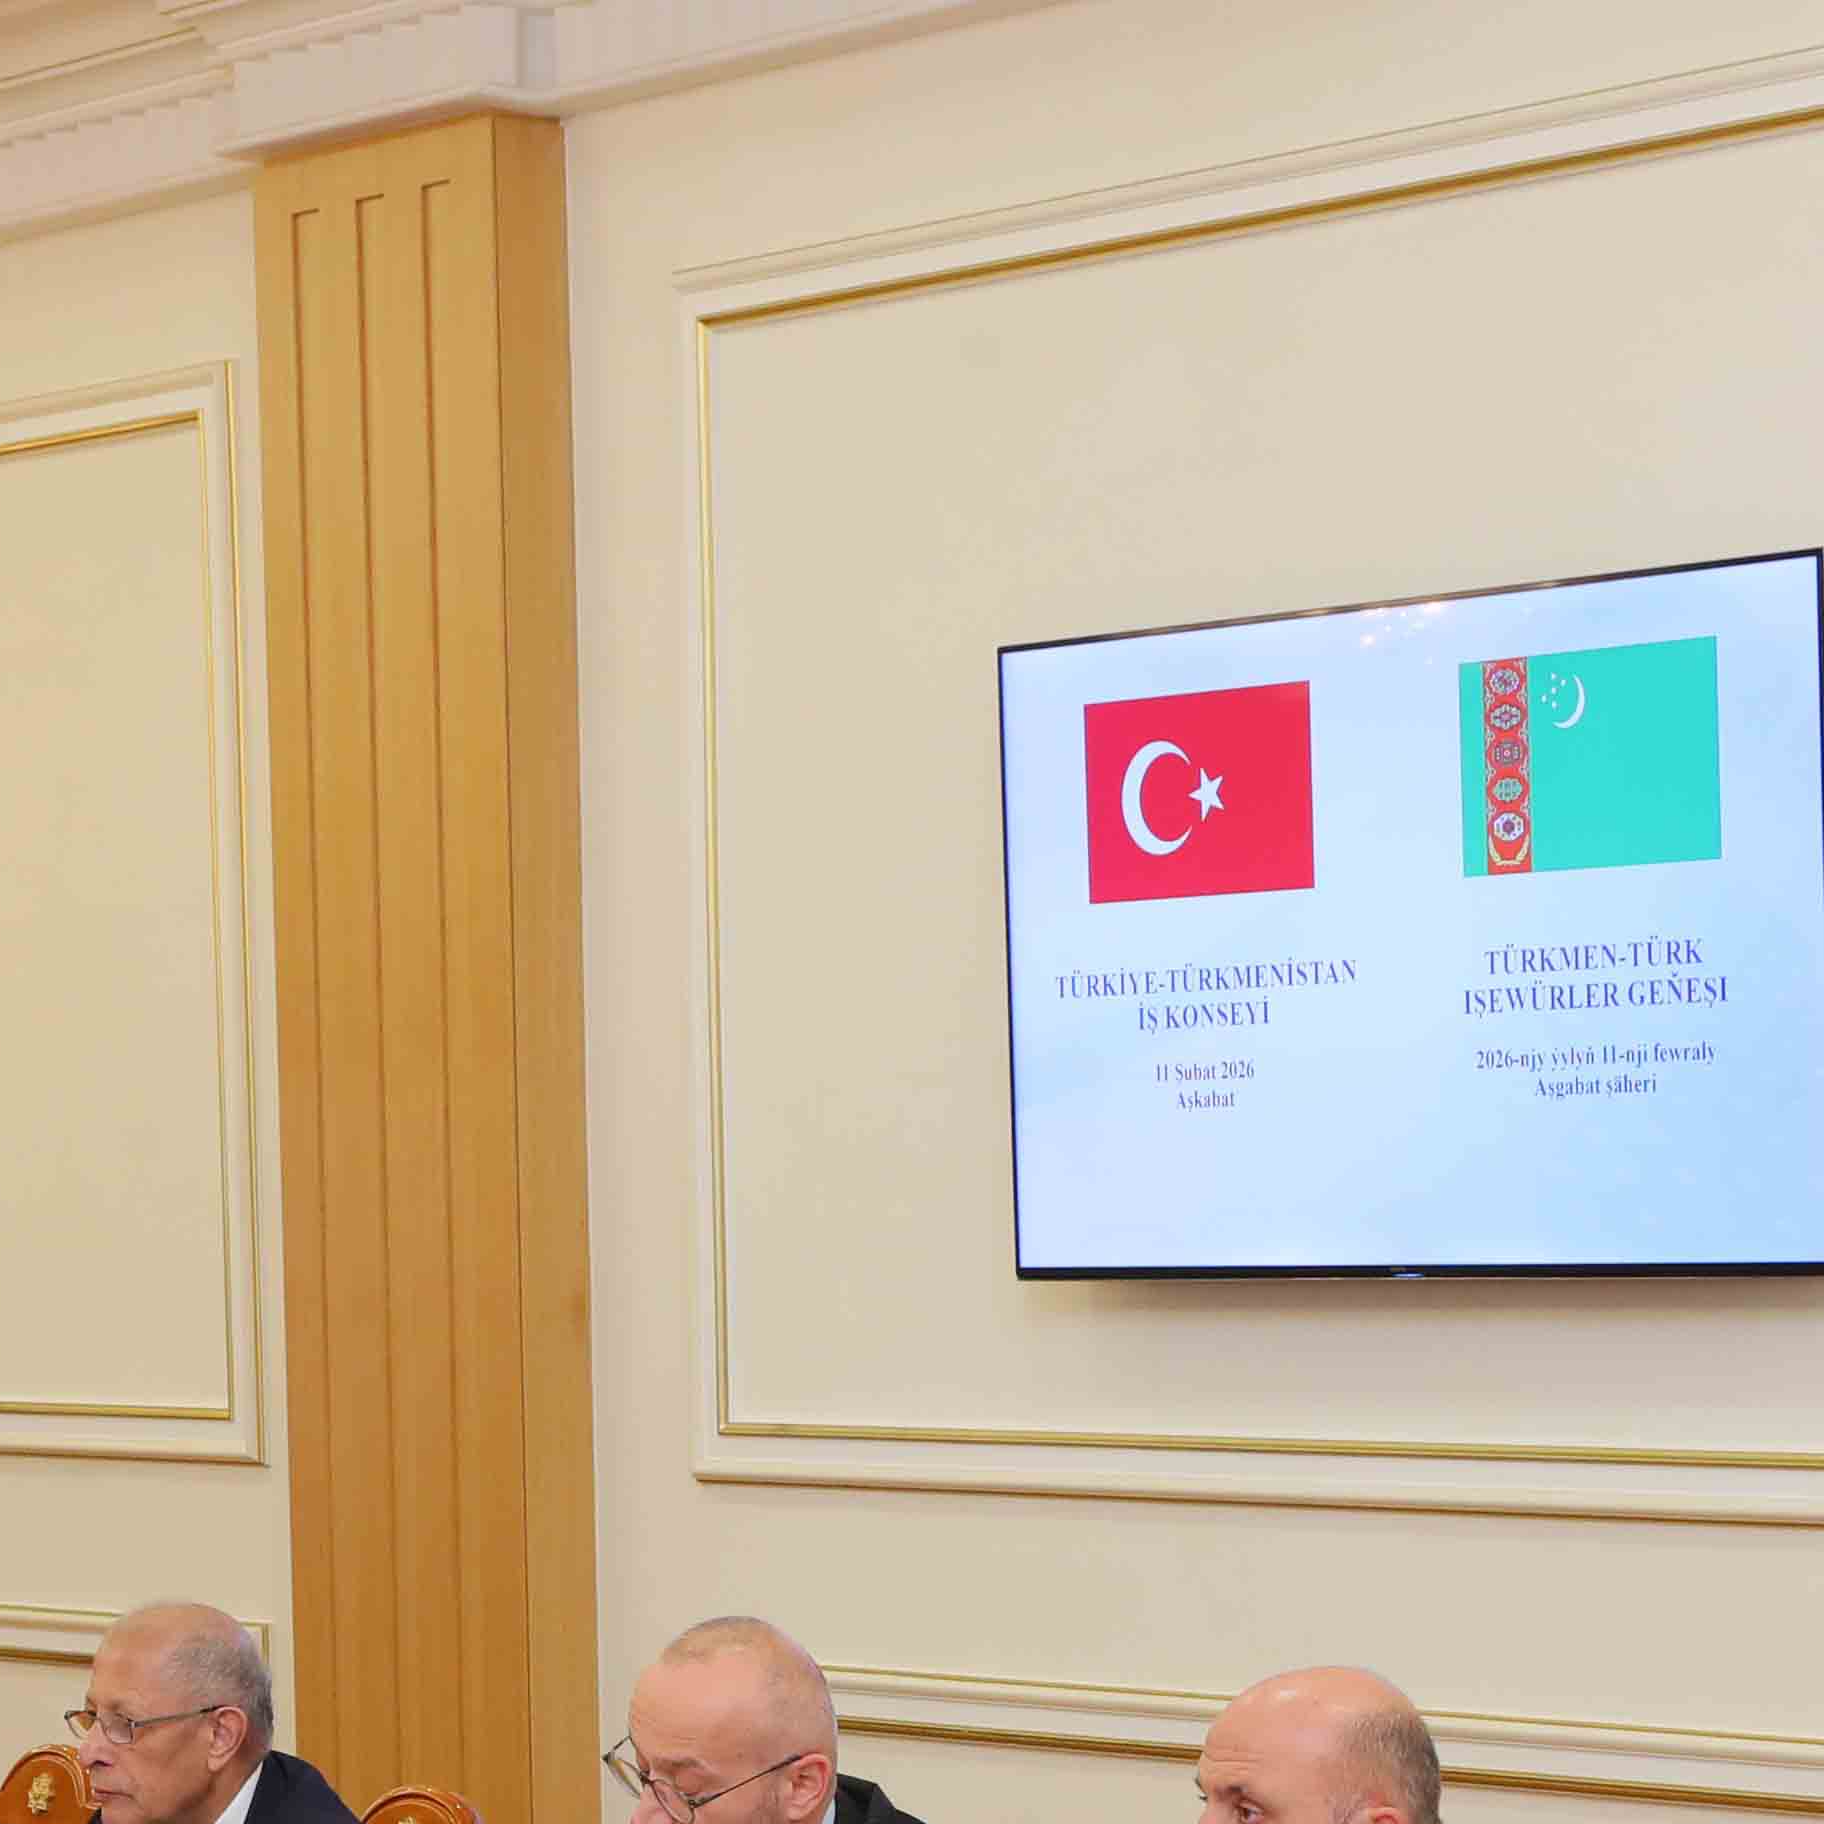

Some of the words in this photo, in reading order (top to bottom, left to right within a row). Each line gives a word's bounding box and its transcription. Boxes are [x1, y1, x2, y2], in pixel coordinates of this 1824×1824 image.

[1485, 936, 1703, 975] TÜRKMEN-TÜRK
[1055, 957, 1357, 999] TÜRKİYE-TÜRKMENİSTAN
[1464, 980, 1620, 1018] IŞEWÜRLER
[1628, 970, 1728, 1008] GEŇEŞI
[1138, 1002, 1159, 1034] İŞ
[1166, 996, 1271, 1030] KONSEYİ
[1221, 1060, 1255, 1080] 2026
[1653, 1040, 1717, 1065] fewraly
[1176, 1089, 1236, 1112] Aşkabat
